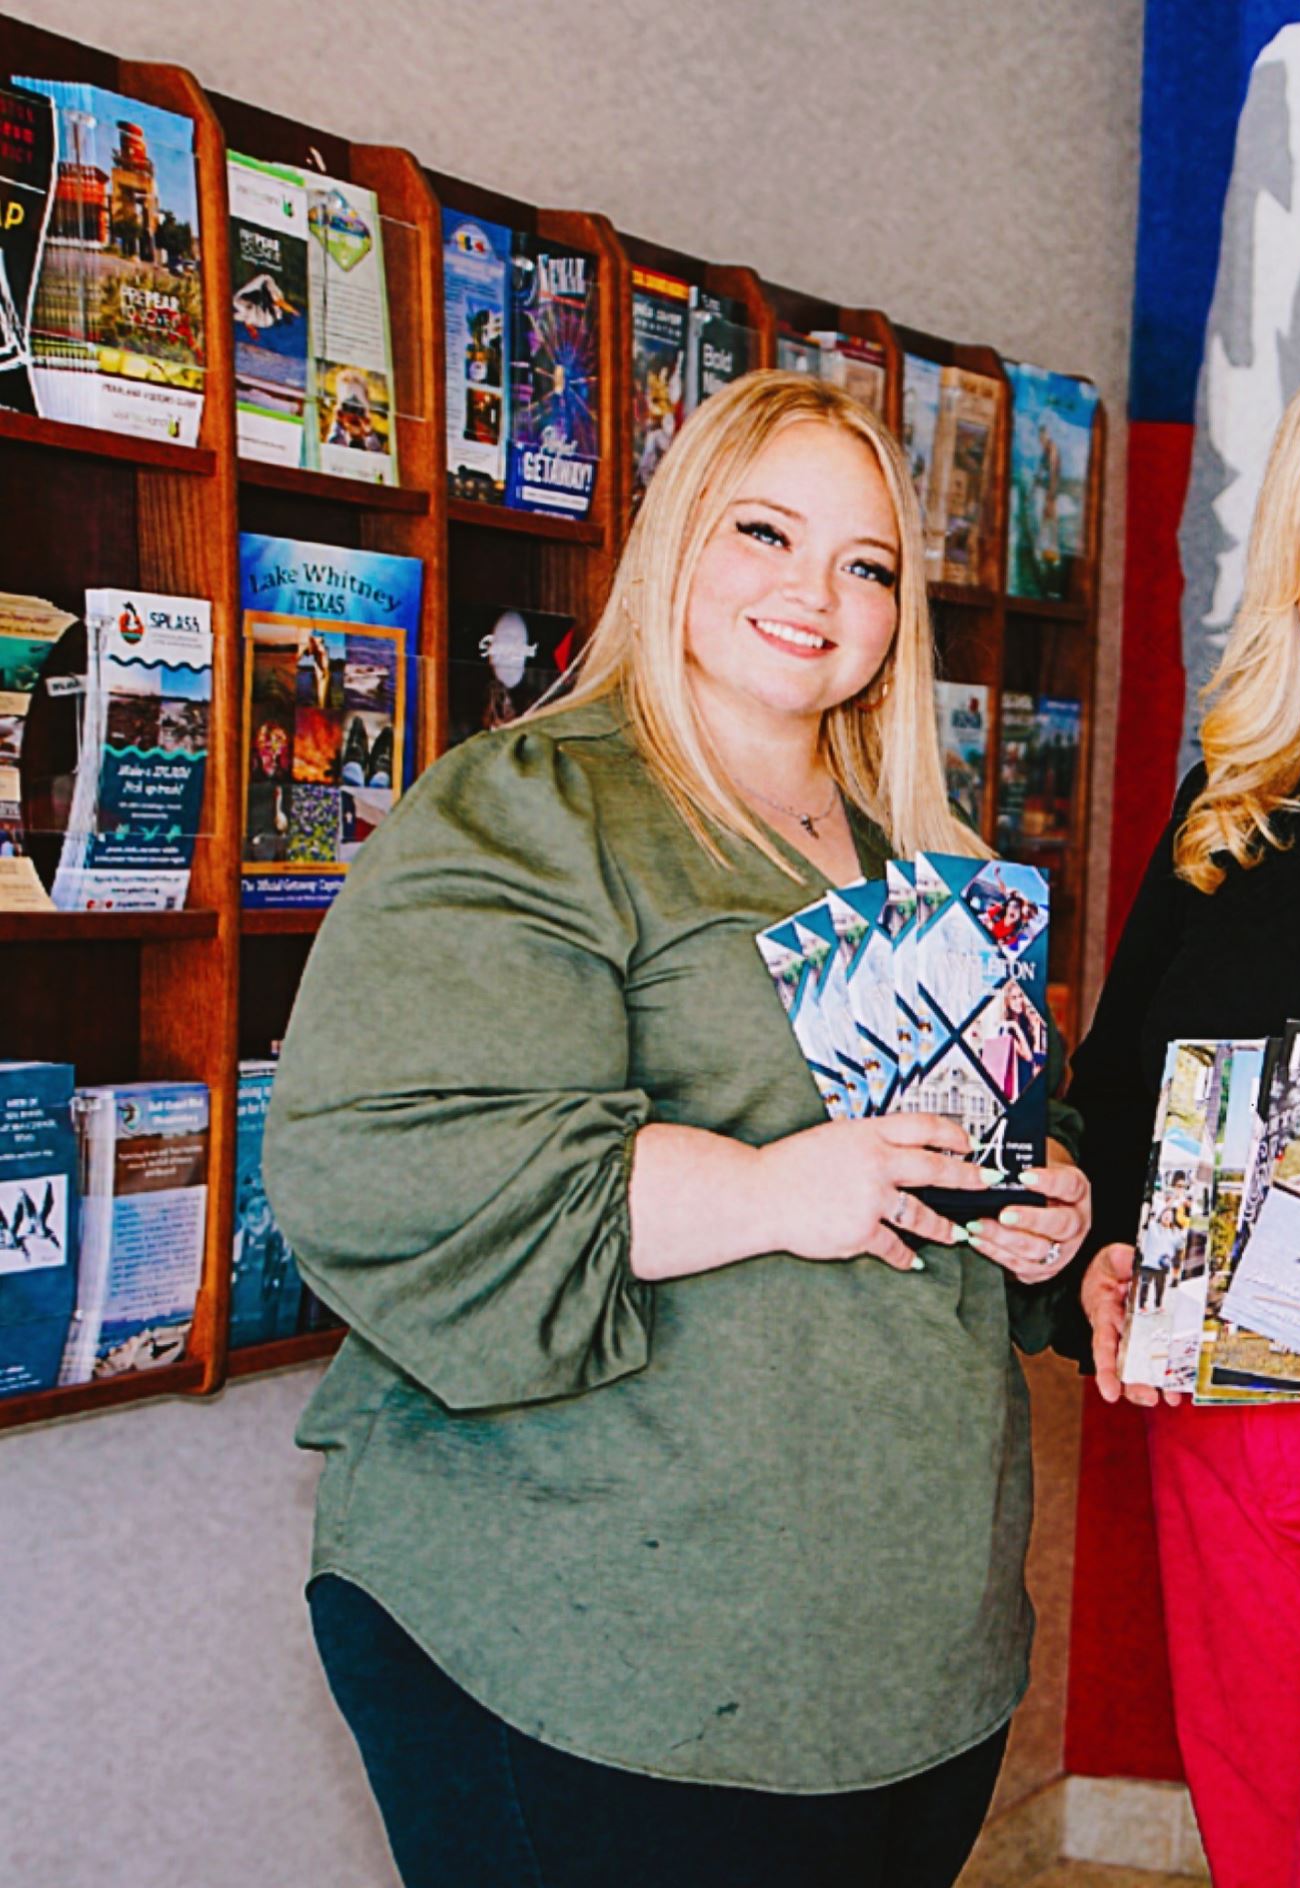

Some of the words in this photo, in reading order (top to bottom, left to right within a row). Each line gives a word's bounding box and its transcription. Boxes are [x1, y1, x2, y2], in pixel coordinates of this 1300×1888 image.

[249, 566, 299, 593] Lake
[302, 563, 402, 612] Whitney
[297, 590, 346, 616] TEXAS
